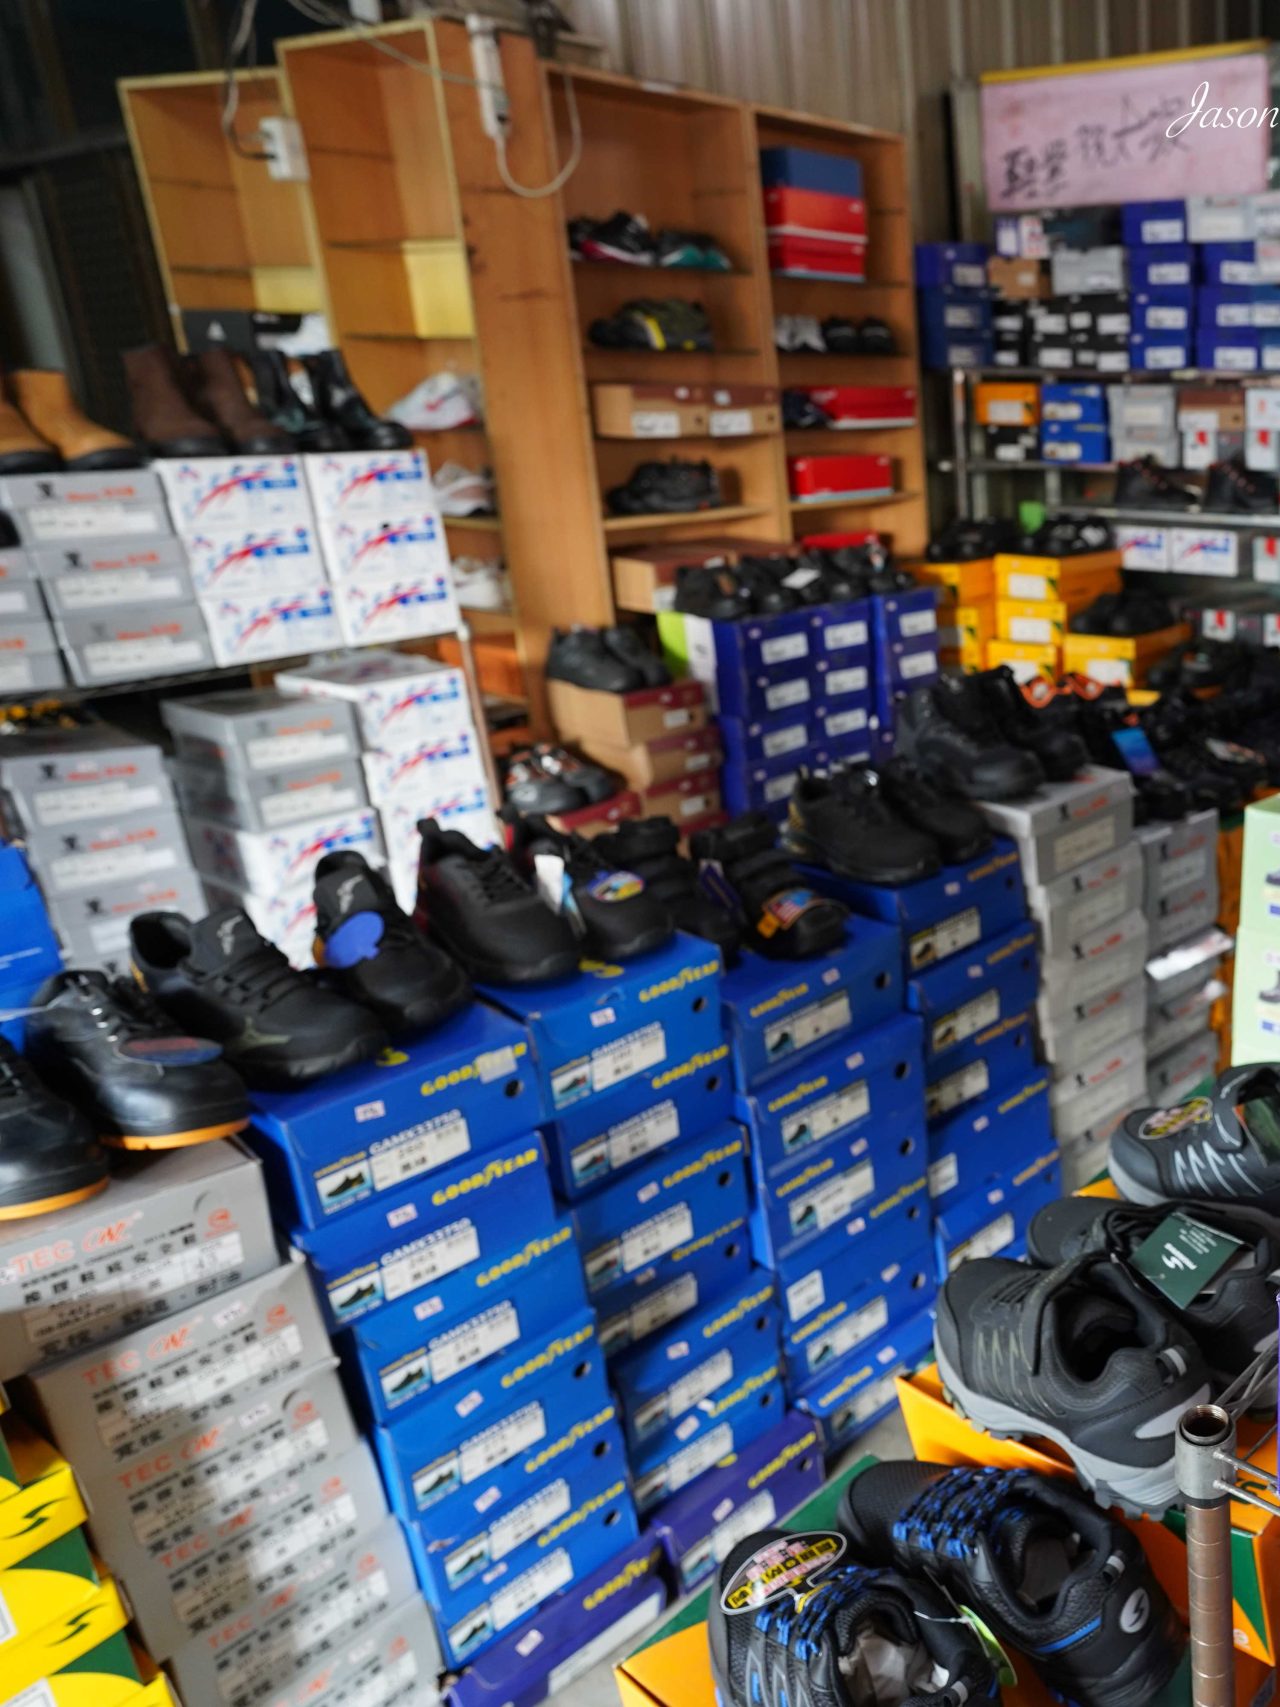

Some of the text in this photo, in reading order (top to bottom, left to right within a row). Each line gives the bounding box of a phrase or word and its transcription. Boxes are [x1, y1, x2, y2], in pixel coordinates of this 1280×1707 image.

[420, 1042, 527, 1097] GOODR
[432, 1149, 537, 1206] GOODYEAR
[10, 1240, 76, 1276] TEC
[476, 1227, 571, 1287] GOODYEAR
[501, 1325, 594, 1389] GOODYEAR
